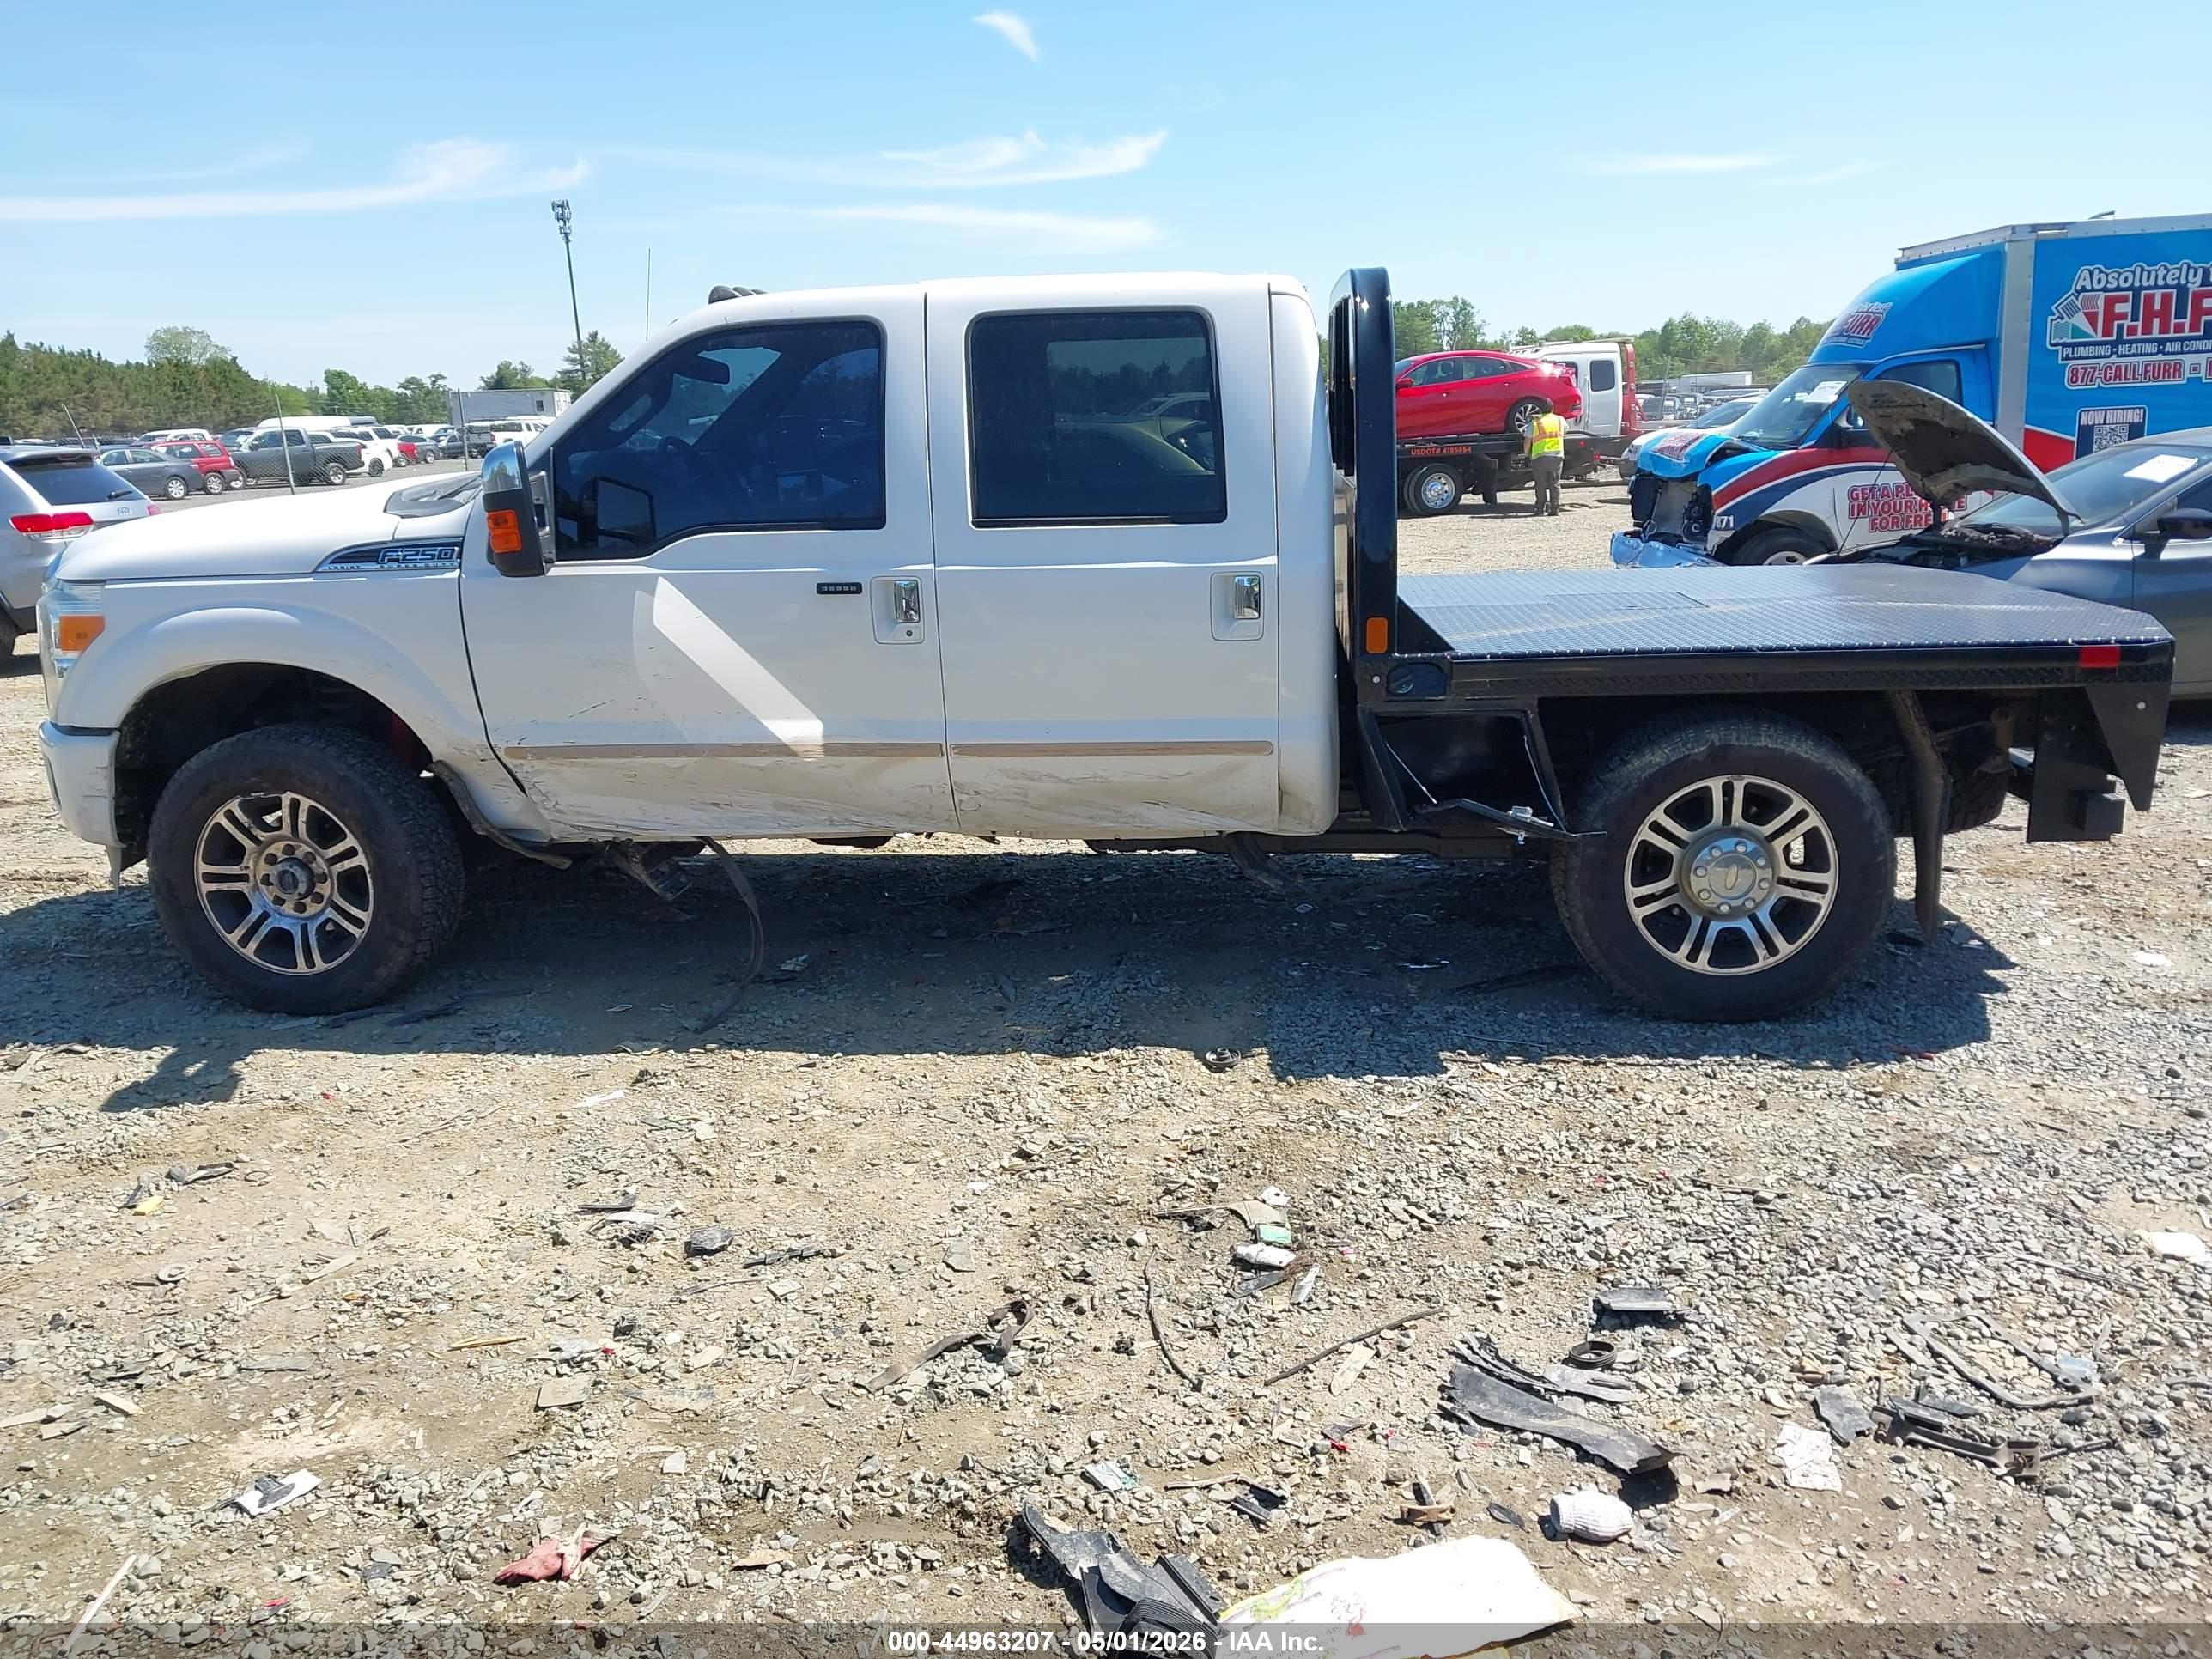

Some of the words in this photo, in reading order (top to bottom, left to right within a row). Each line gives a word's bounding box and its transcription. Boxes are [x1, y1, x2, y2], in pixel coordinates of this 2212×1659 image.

[2076, 262, 2203, 289] Absolutely
[2063, 344, 2112, 358] PLUMBING
[2118, 342, 2159, 356] HEATING
[2165, 341, 2182, 353] AIR
[2069, 362, 2141, 386] 877-CALL
[2142, 360, 2185, 382] FURR
[2081, 410, 2106, 426] NOW
[2106, 409, 2144, 424] HIRING!
[1411, 447, 1441, 455] USDOT#
[1849, 485, 1879, 502] GET
[1880, 483, 1891, 501] A
[1849, 501, 1869, 519] IN
[1869, 499, 1916, 517] YOUR
[1869, 514, 1902, 532] FOR
